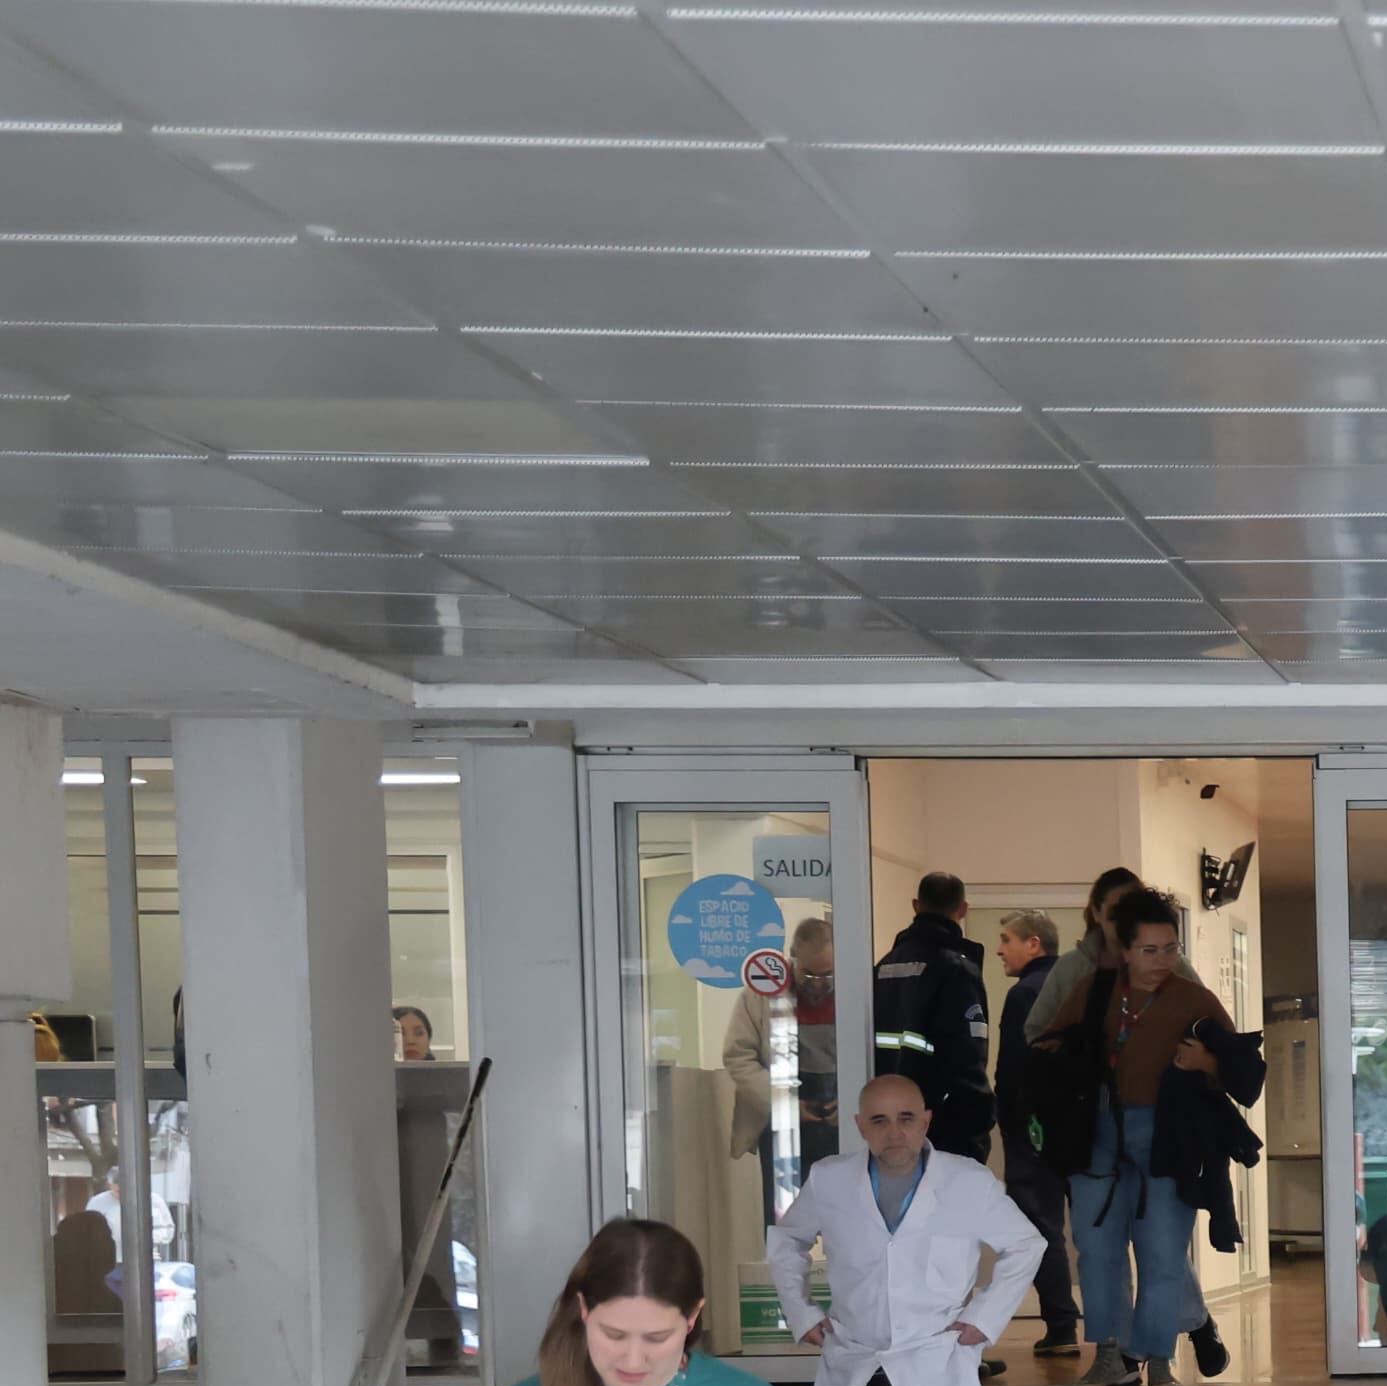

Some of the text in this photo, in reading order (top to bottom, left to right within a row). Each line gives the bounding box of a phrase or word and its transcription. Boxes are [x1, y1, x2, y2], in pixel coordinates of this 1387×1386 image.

[699, 900, 750, 913] ESPACIO
[701, 914, 749, 928] LIBRE DE
[736, 929, 751, 942] DE
